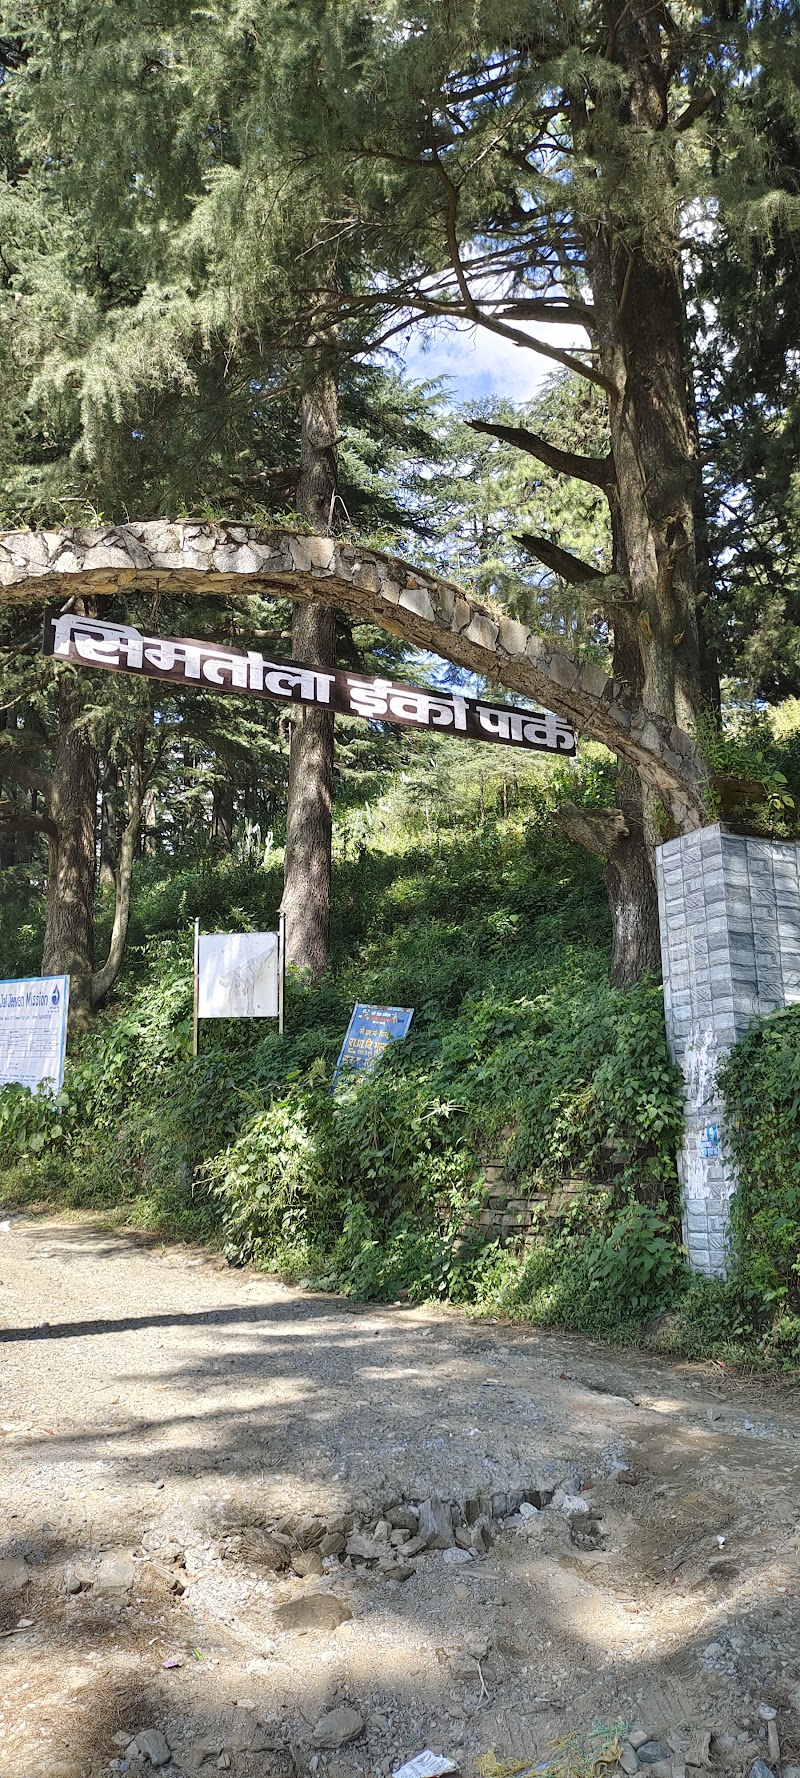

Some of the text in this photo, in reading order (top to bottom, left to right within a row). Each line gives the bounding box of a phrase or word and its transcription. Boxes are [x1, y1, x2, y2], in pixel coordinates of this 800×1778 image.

[347, 678, 469, 731] ईको
[476, 706, 574, 750] पार्क
[8, 993, 24, 1008] Jeevan
[26, 991, 49, 1007] Mission
